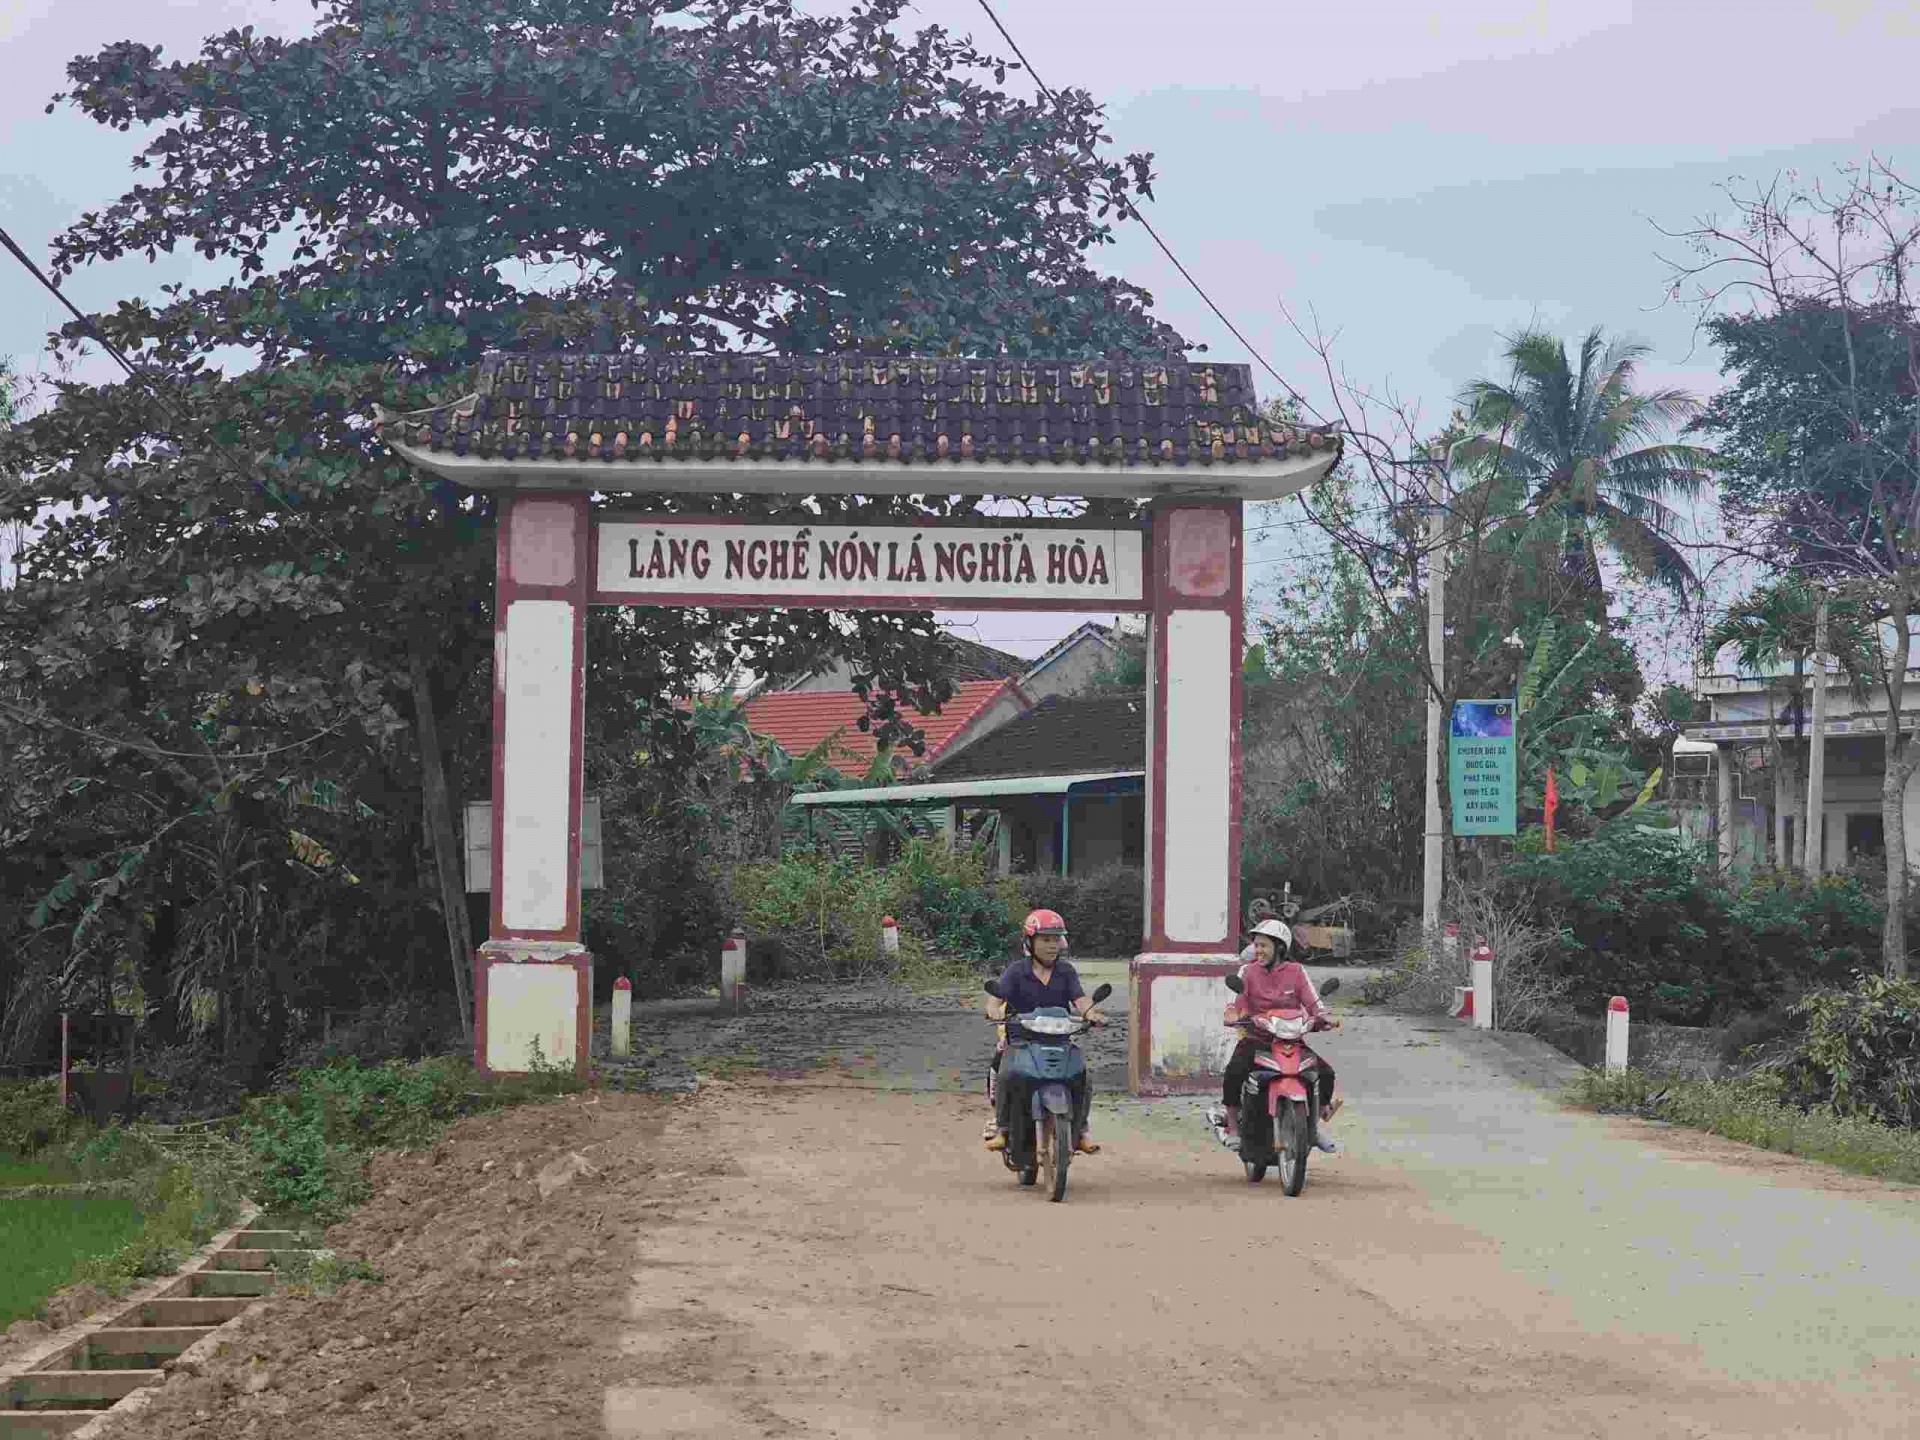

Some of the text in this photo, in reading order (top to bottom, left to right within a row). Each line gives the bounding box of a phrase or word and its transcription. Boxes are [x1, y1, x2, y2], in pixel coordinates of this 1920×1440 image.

[628, 527, 1109, 584] LÀNG NGHỀ NÓN LÁ NGHĨA HÒA
